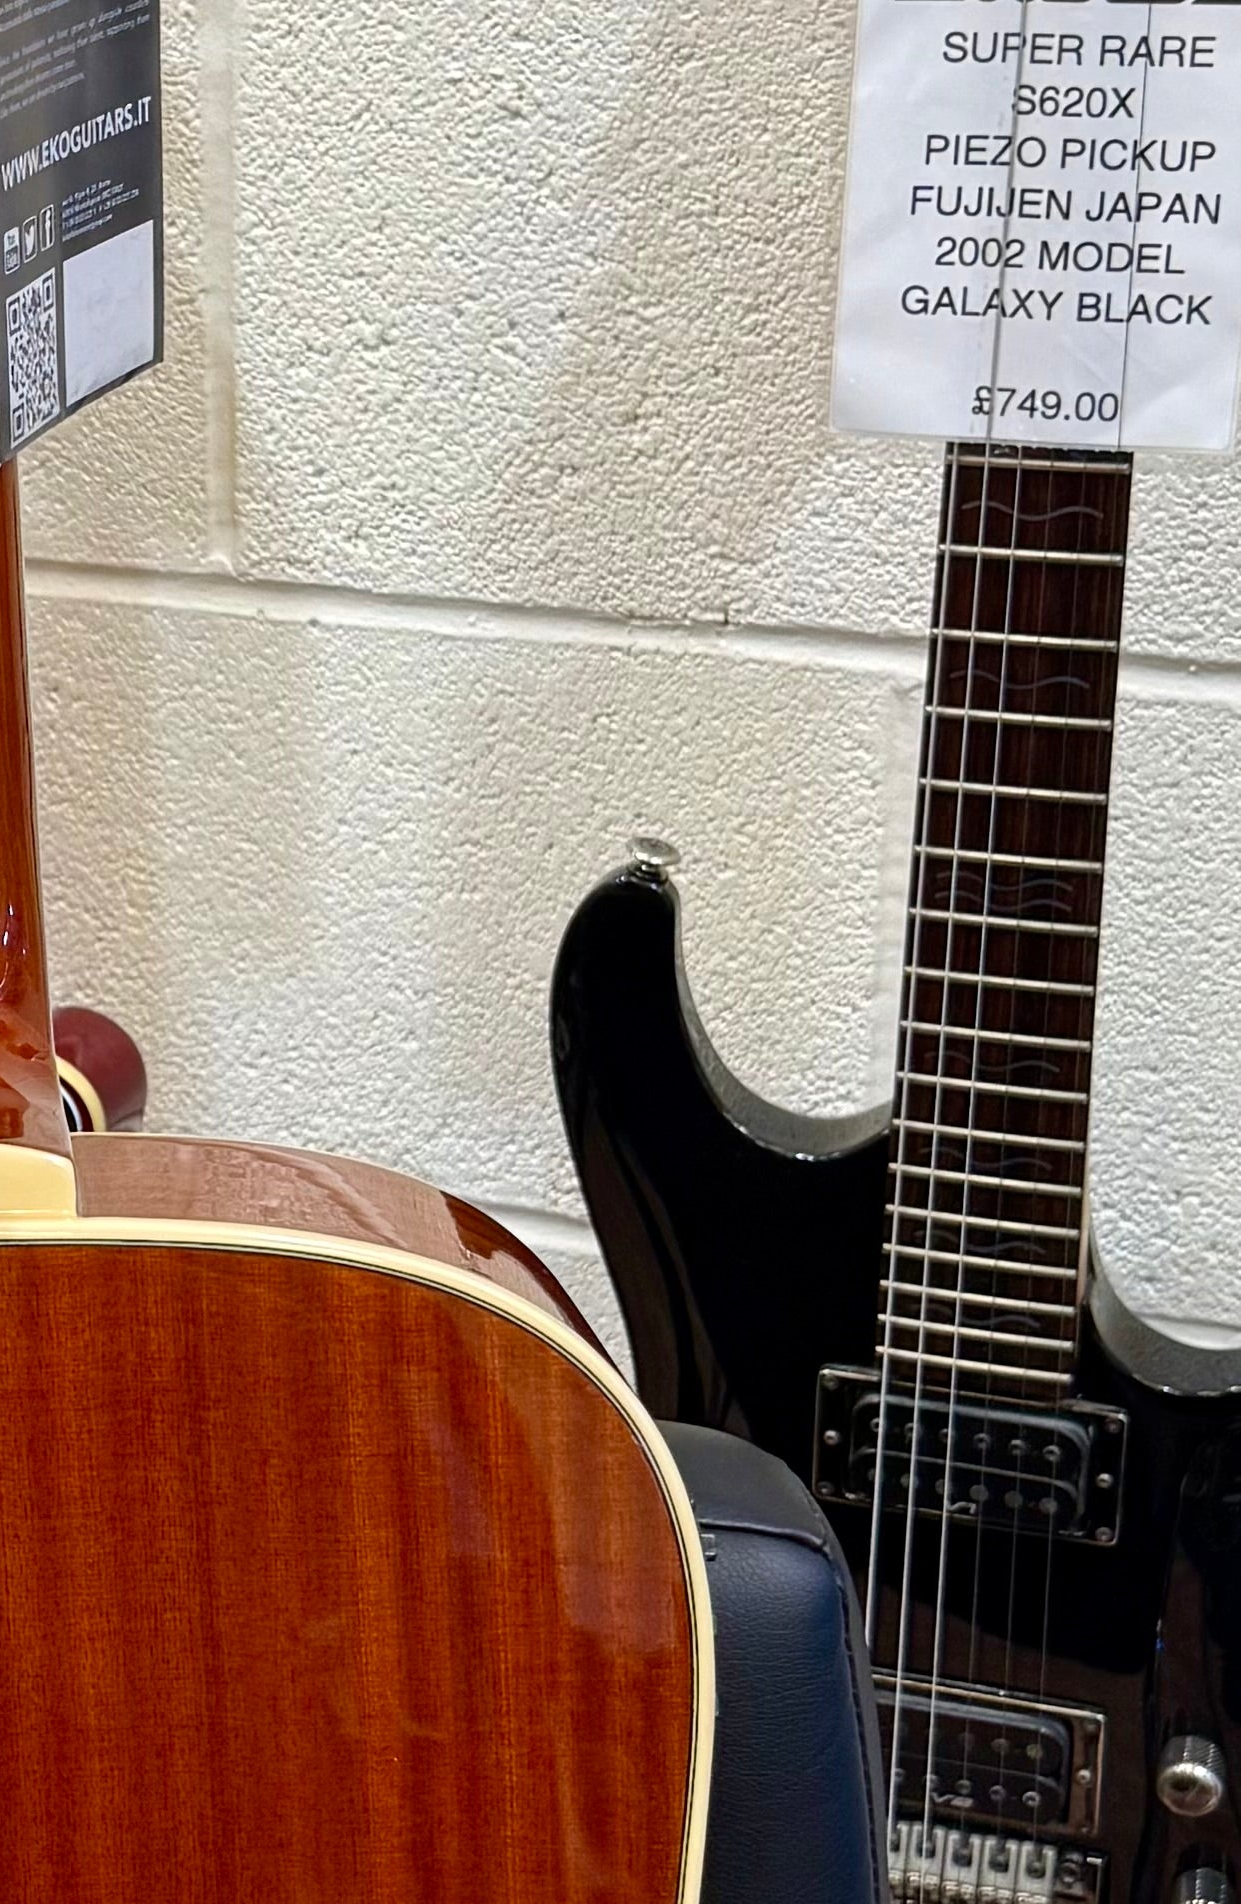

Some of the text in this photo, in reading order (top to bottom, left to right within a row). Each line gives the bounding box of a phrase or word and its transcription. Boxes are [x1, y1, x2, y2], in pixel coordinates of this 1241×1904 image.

[942, 31, 1217, 69] SUPER RARE
[1011, 84, 1137, 119] S620X
[0, 95, 152, 192] WWW.EKOGUITARS.IT
[924, 134, 1218, 173] PIEZO PICKUP
[910, 184, 1222, 225] FUJIJEN JAPAN
[934, 235, 1186, 275] 2002 MODEL
[900, 283, 1214, 326] GALAXY BLACK
[971, 384, 1120, 423] £749.00
